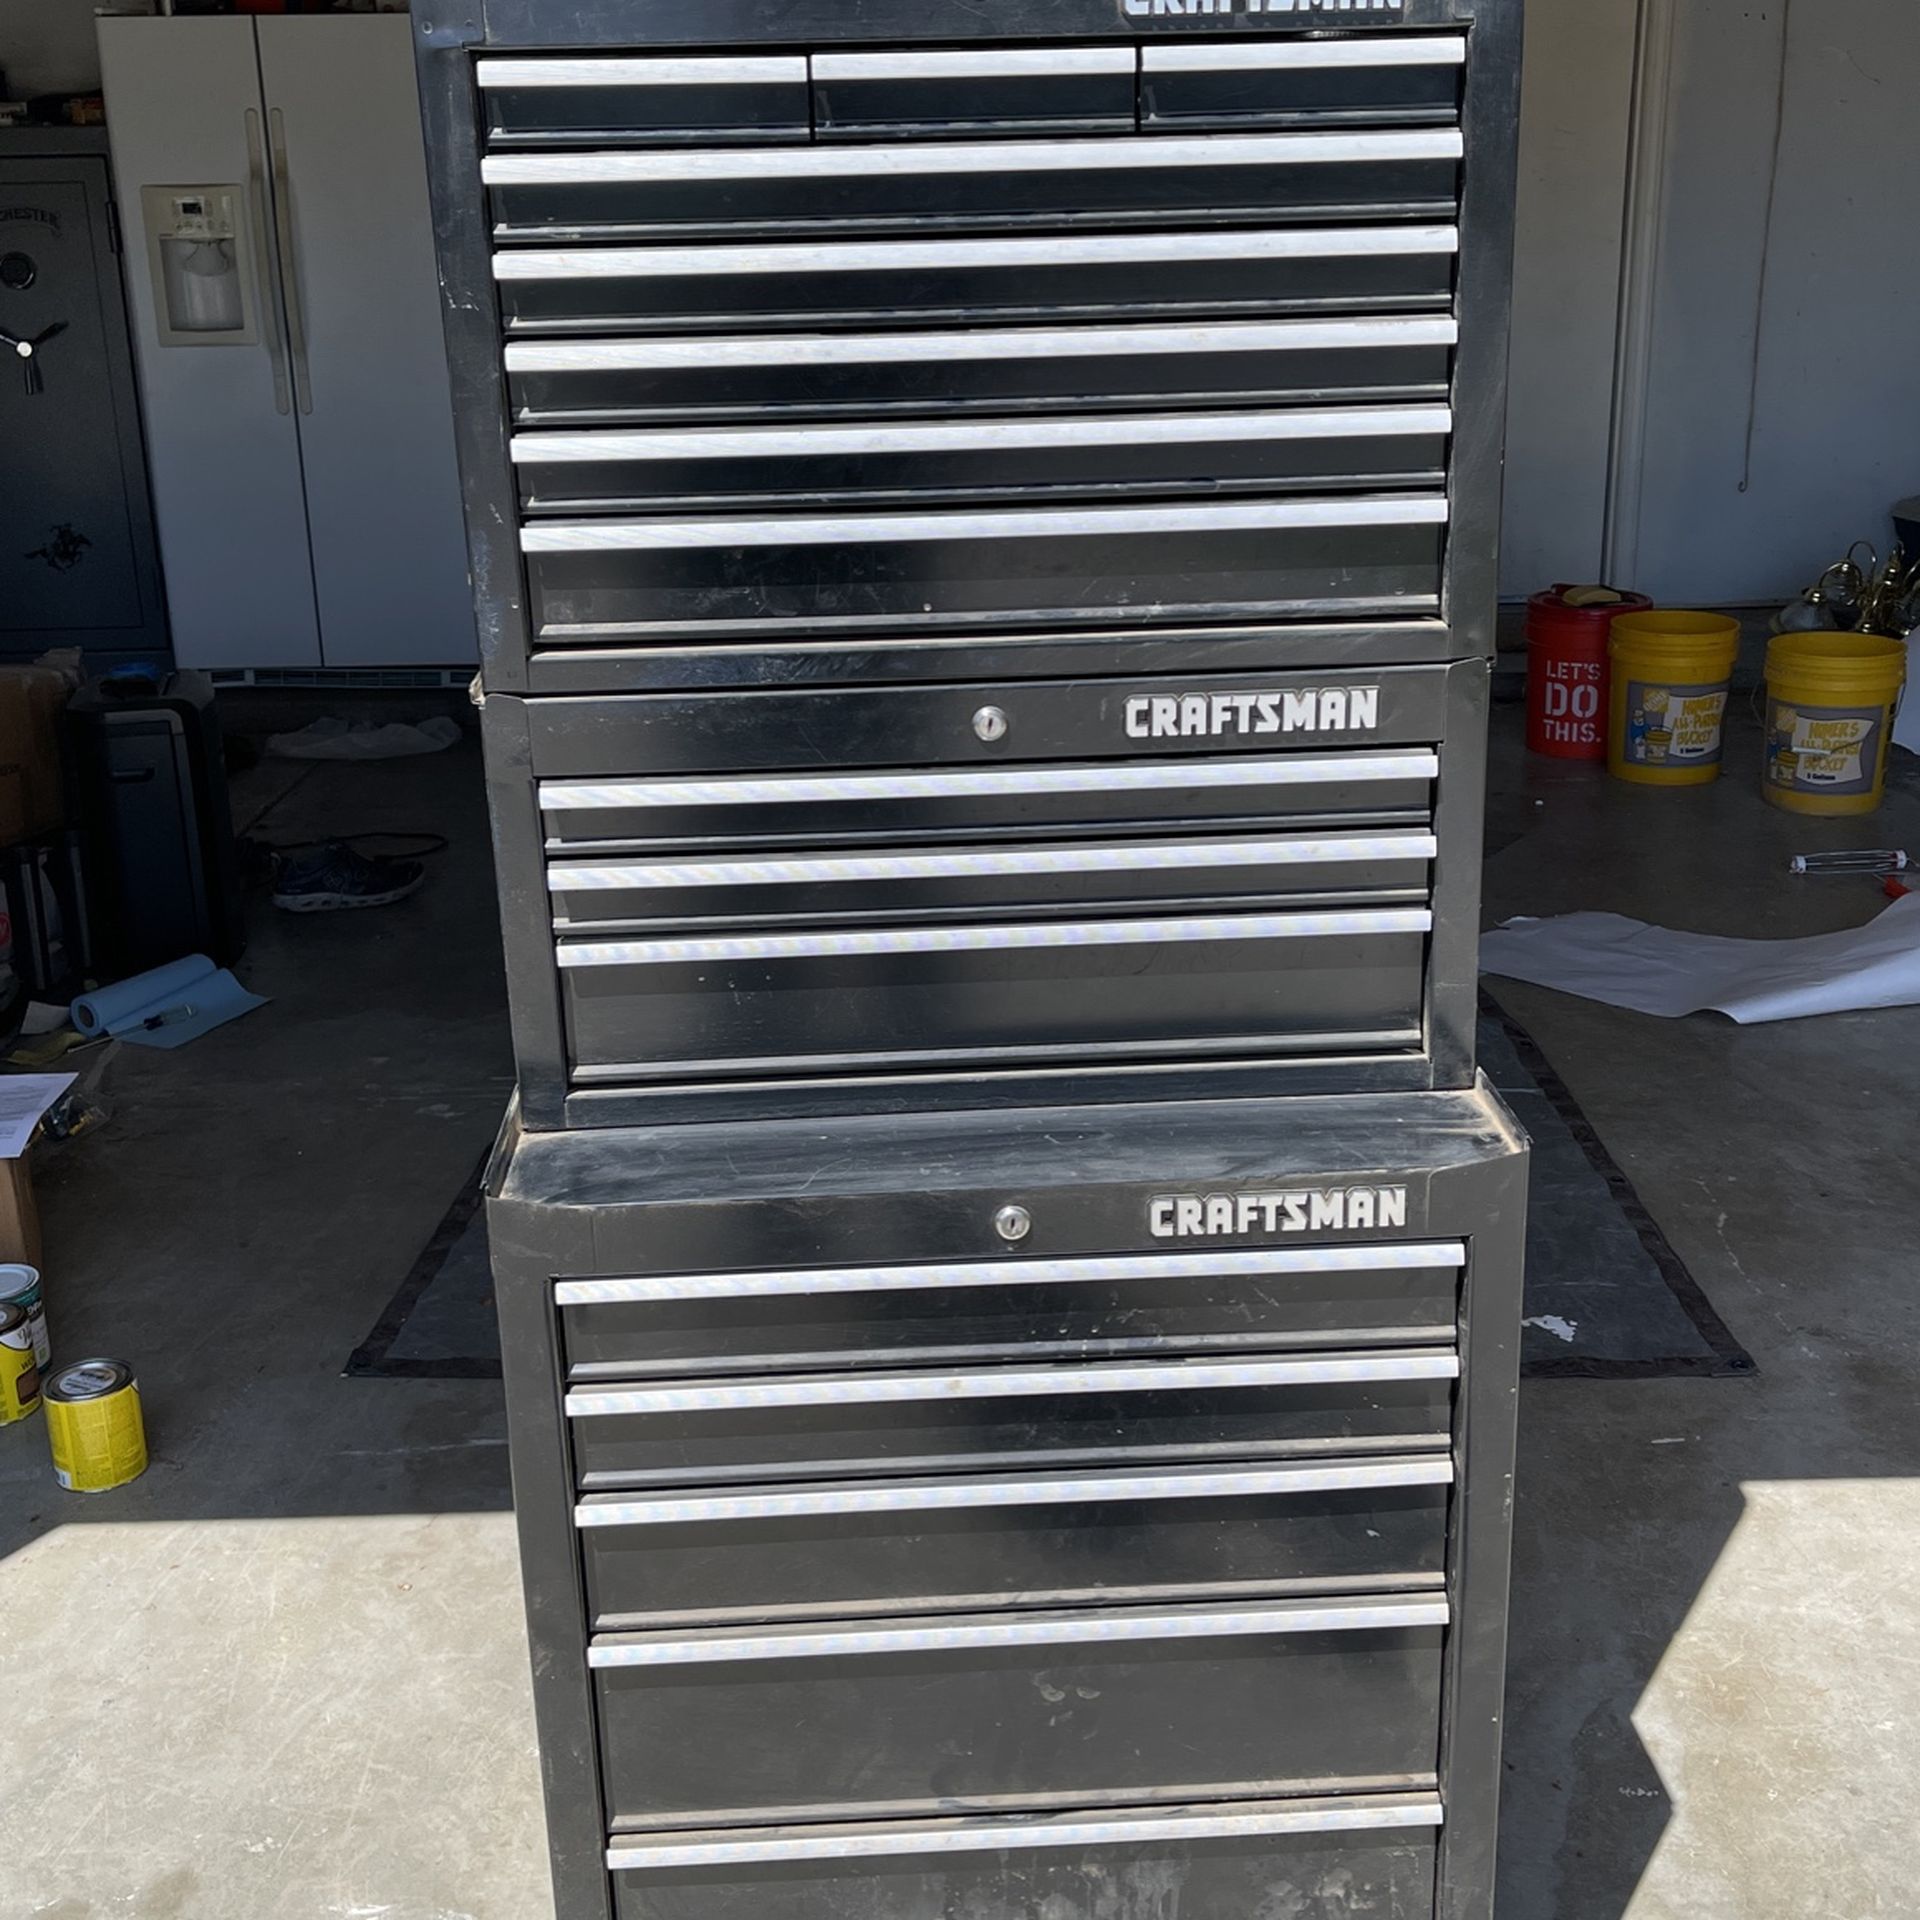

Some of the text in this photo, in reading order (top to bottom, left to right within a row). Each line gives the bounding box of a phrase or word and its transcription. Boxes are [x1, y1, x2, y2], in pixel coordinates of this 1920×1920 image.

[1546, 659, 1601, 680] LET'S
[1125, 687, 1380, 738] CRAFTSMAN
[1544, 681, 1599, 718] DO
[1542, 719, 1603, 743] THIS.
[1148, 1186, 1408, 1237] CRAFTSMAN
